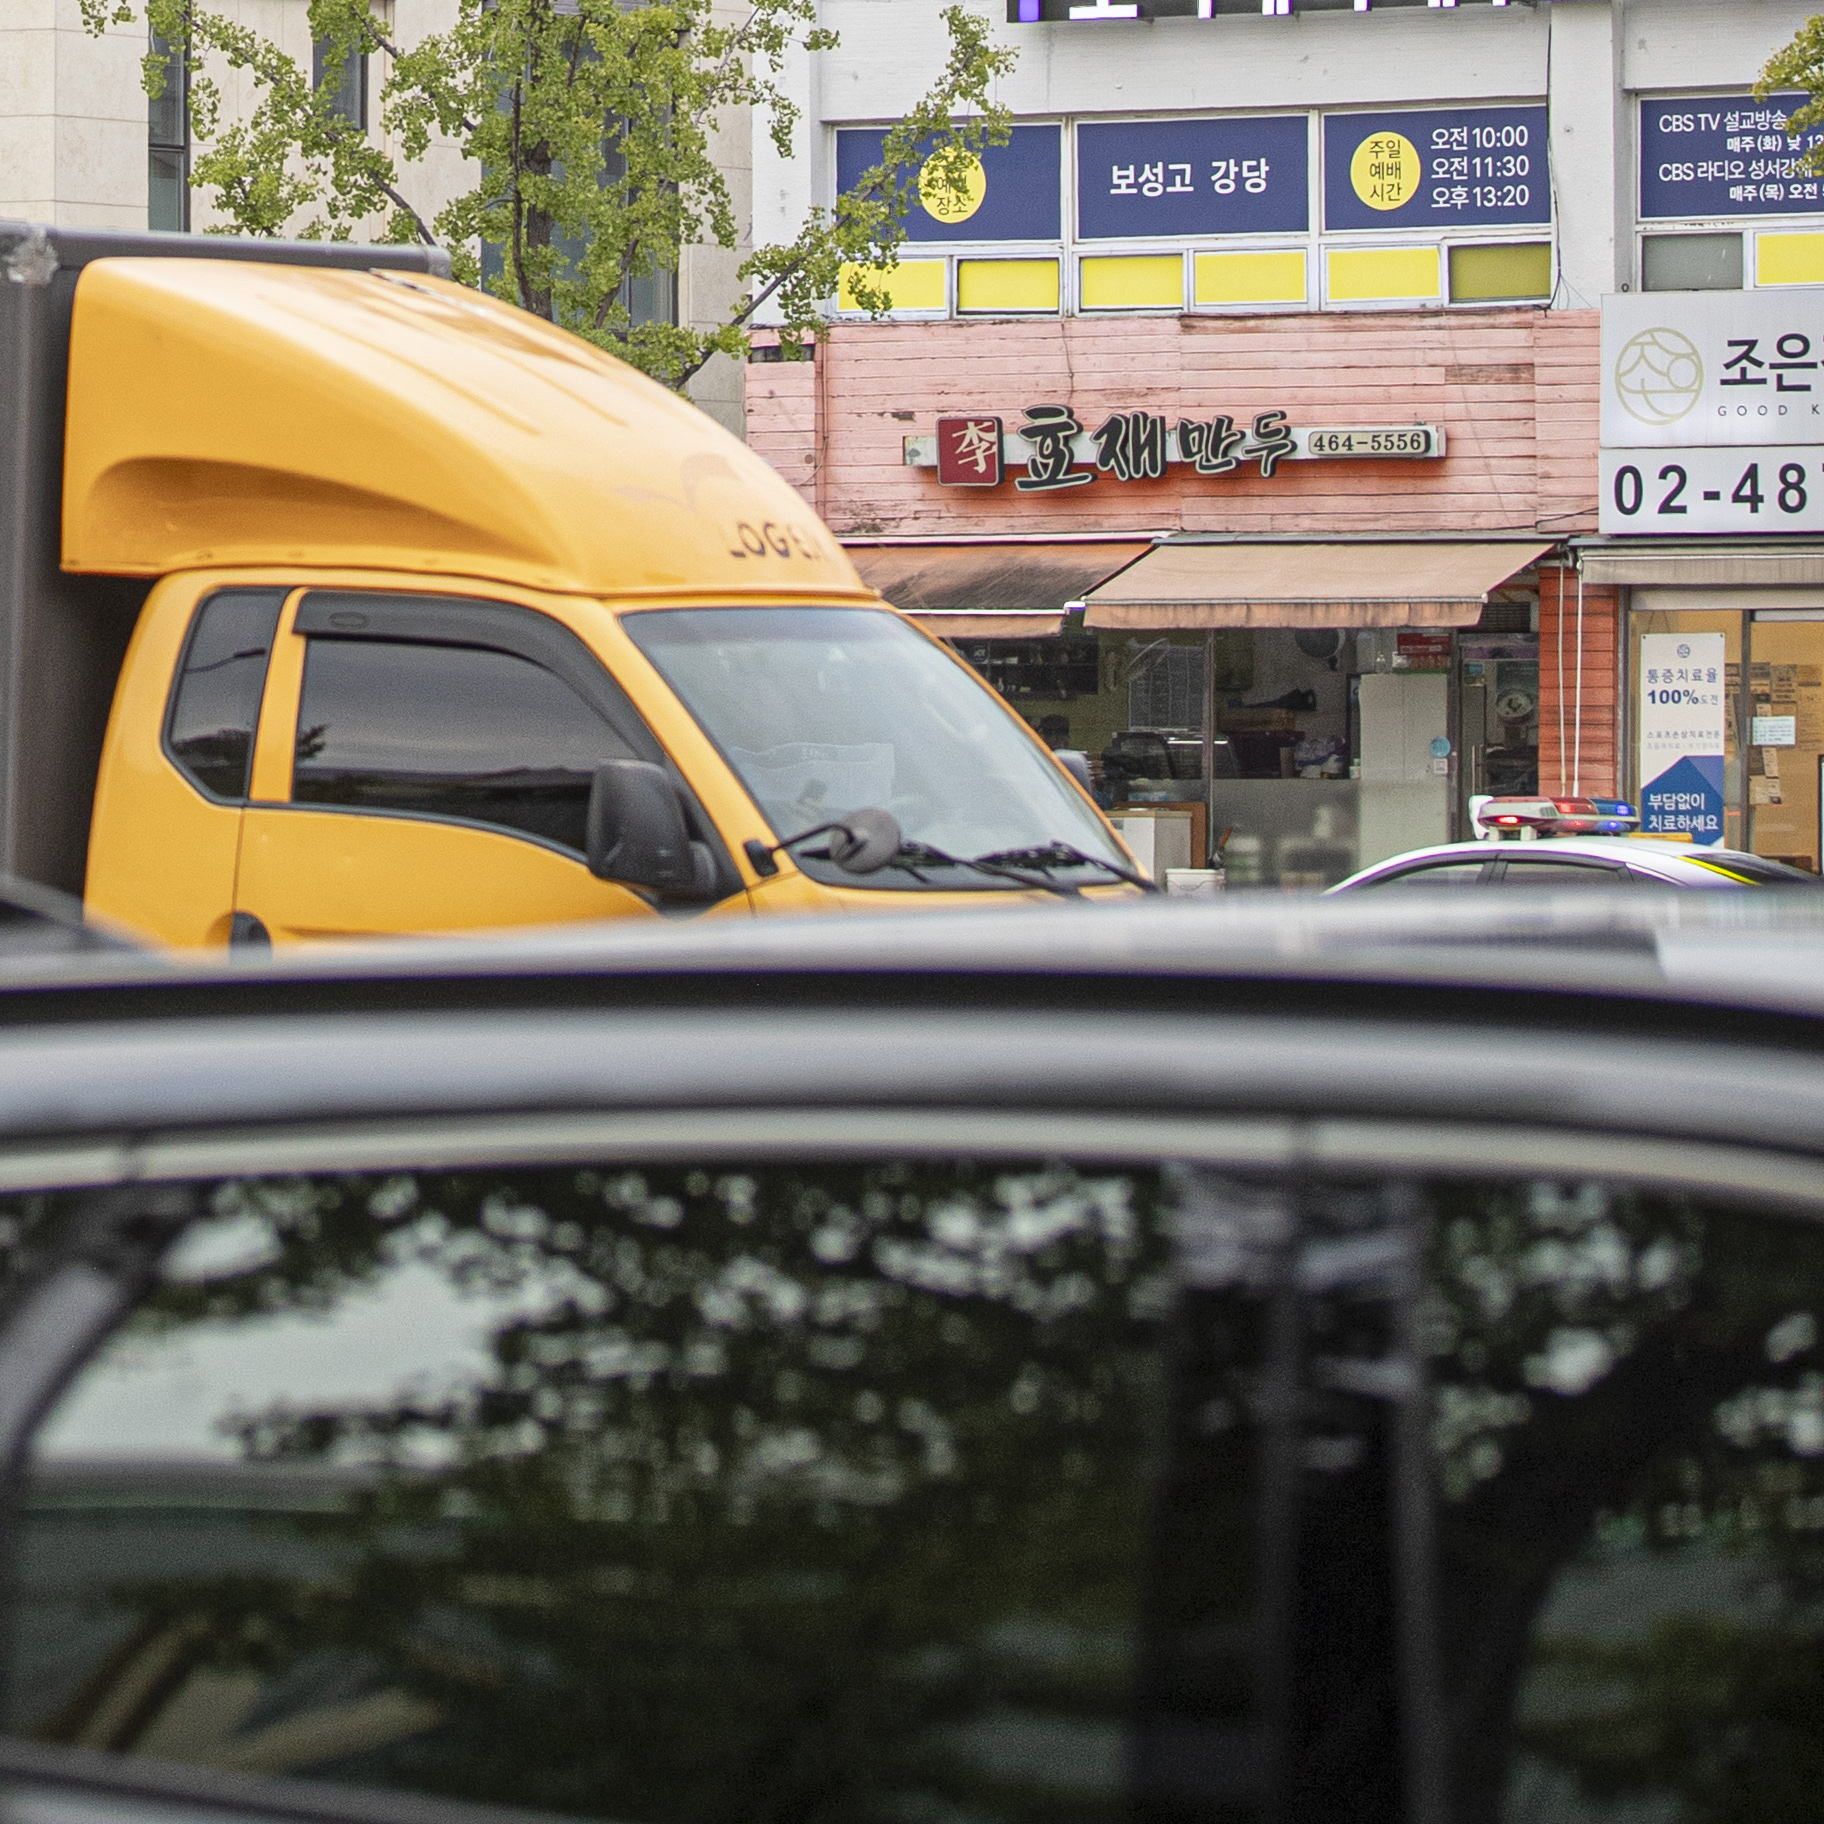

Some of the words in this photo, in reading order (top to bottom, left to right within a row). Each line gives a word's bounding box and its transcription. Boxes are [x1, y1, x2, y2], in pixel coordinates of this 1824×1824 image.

[1659, 114, 1694, 133] CBS
[1697, 113, 1720, 131] TV
[1724, 110, 1788, 132] 설교방송
[1369, 139, 1402, 159] 주일
[1430, 126, 1469, 152] 오전
[1473, 125, 1530, 148] 10:00
[1110, 162, 1194, 198] 보성고
[1210, 158, 1270, 194] 강당
[1369, 161, 1402, 181] 예배
[1430, 157, 1469, 181] 오전
[1473, 155, 1530, 178] 11:30
[1659, 163, 1694, 182] CBS
[1697, 160, 1746, 182] 라디오
[1369, 182, 1403, 203] 시간
[1430, 186, 1469, 210] 오후
[1474, 185, 1530, 208] 13:20
[1787, 183, 1818, 200] 오전
[936, 195, 968, 215] 장소
[1719, 332, 1824, 392] 조은
[1717, 404, 1788, 417] GOOD
[950, 421, 998, 474] 李
[1014, 405, 1299, 493] 효재만두
[1312, 432, 1424, 453] 464-5556
[1614, 462, 1824, 516] 02-48
[1646, 667, 1719, 685] 통증치료율
[1647, 792, 1706, 811] 부담없이
[1647, 814, 1719, 833] 치료하세요
